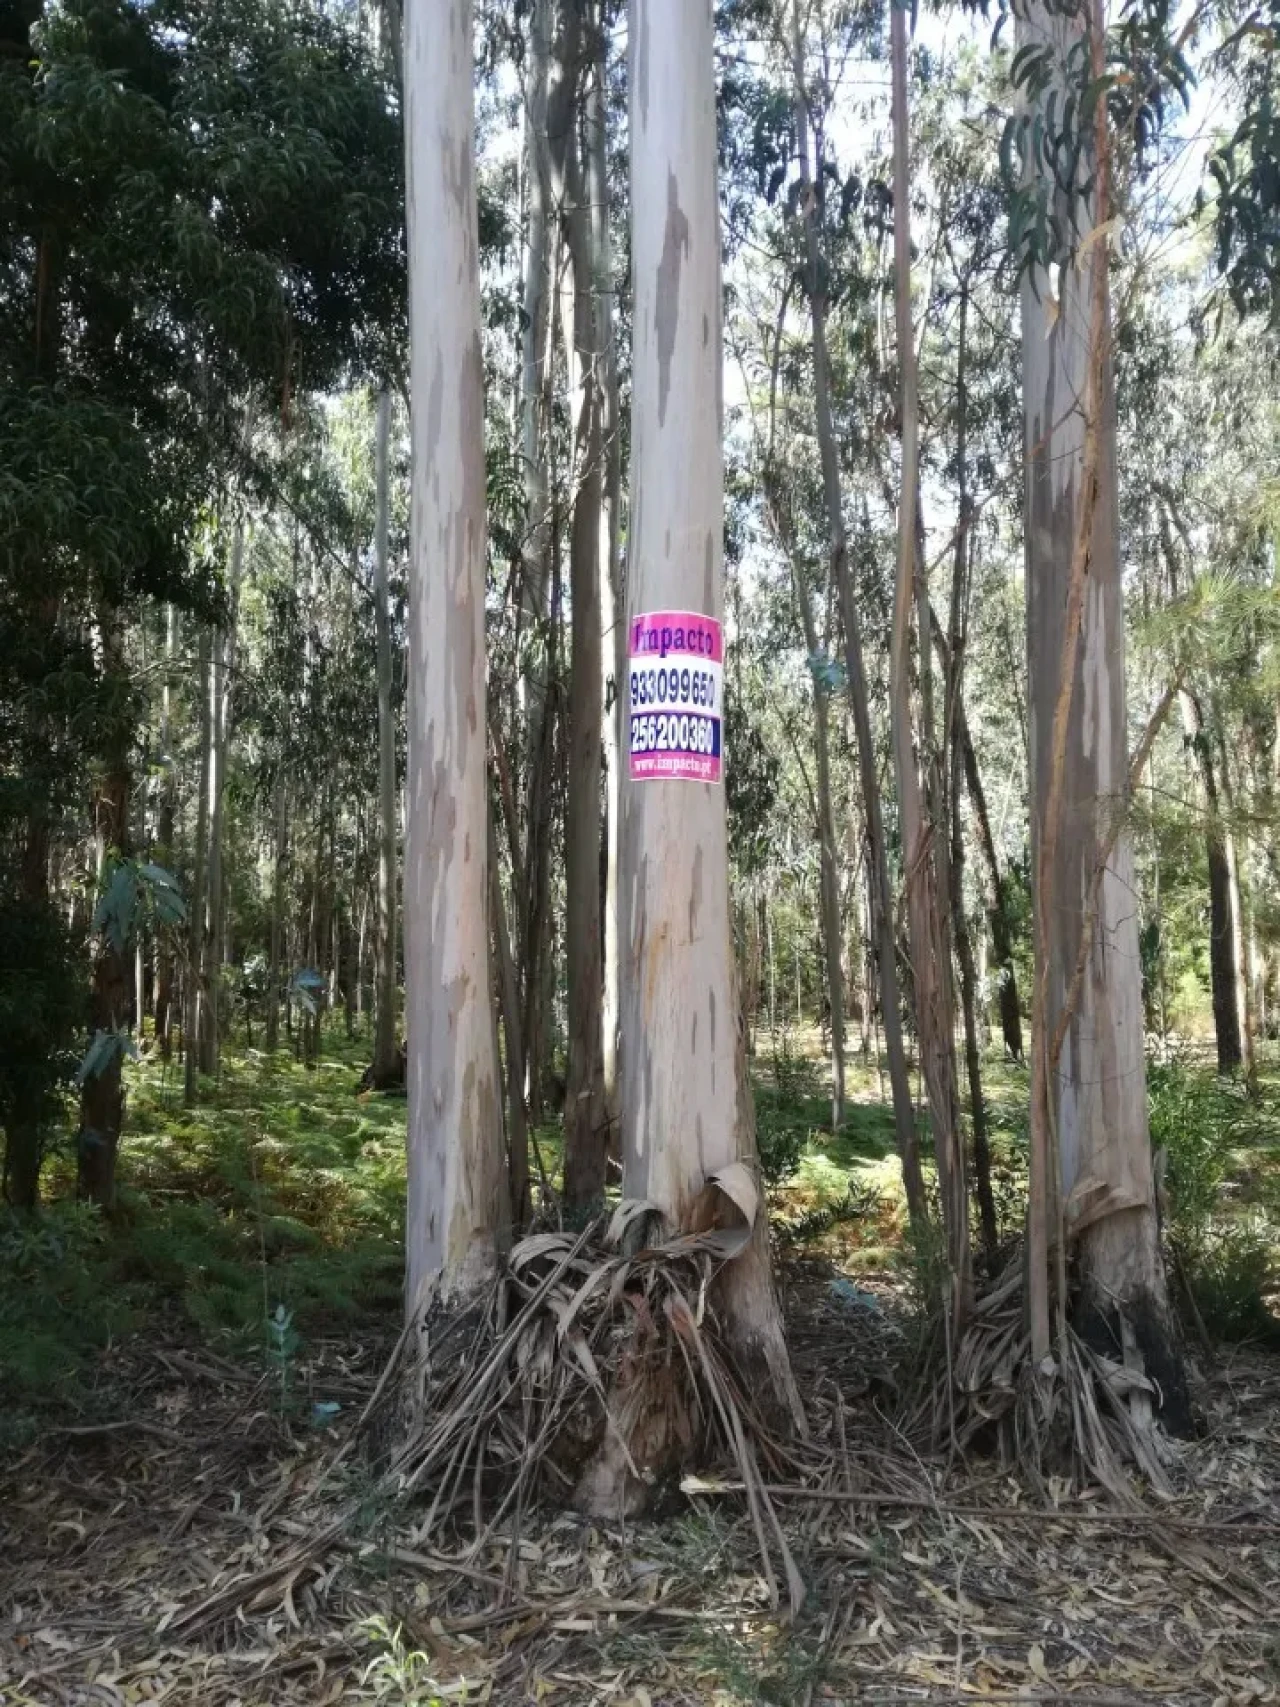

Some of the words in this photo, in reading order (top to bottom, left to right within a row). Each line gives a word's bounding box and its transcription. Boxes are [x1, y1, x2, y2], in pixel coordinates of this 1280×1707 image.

[634, 623, 713, 658] Impacto
[631, 668, 715, 708] 933099650
[632, 715, 713, 754] 256200360
[634, 754, 711, 777] www.impacto.pt
